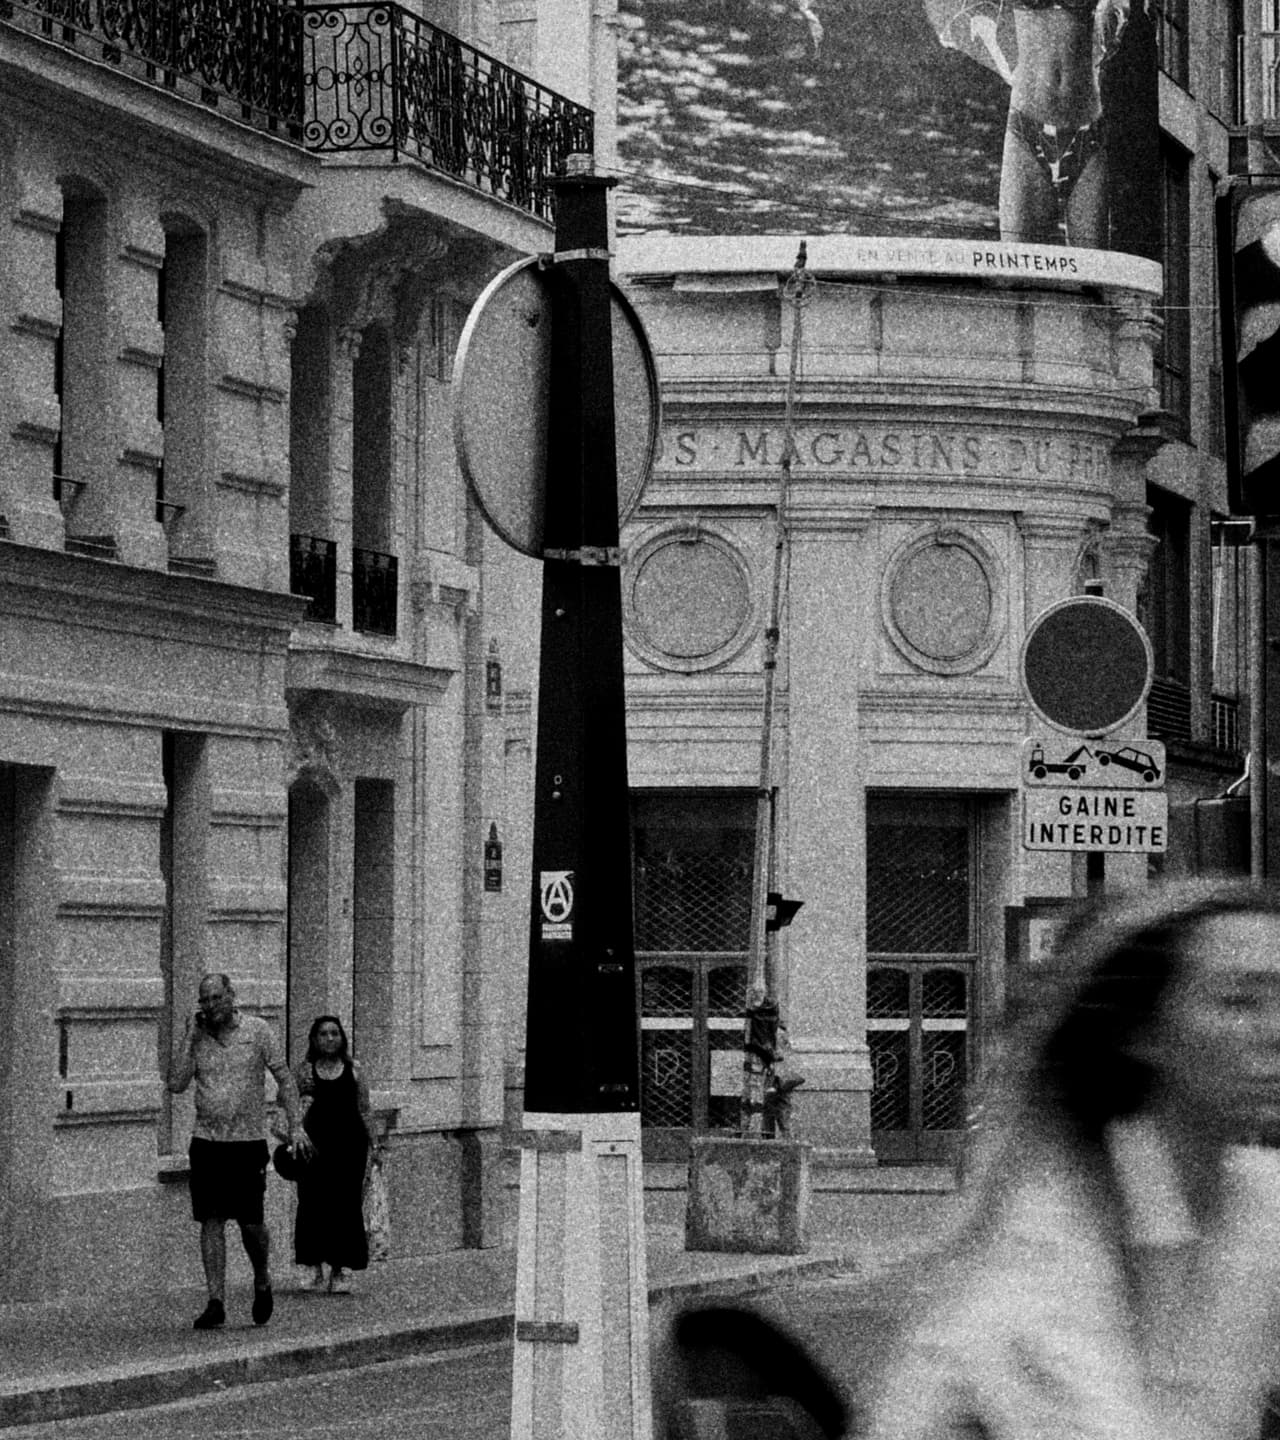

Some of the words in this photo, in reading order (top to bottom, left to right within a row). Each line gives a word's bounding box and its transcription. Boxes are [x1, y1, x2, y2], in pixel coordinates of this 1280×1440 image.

[973, 251, 1078, 272] PRINTEMPS
[734, 431, 984, 471] MAGASINS
[1058, 795, 1136, 818] GAINE
[1029, 822, 1163, 847] INTERDITE
